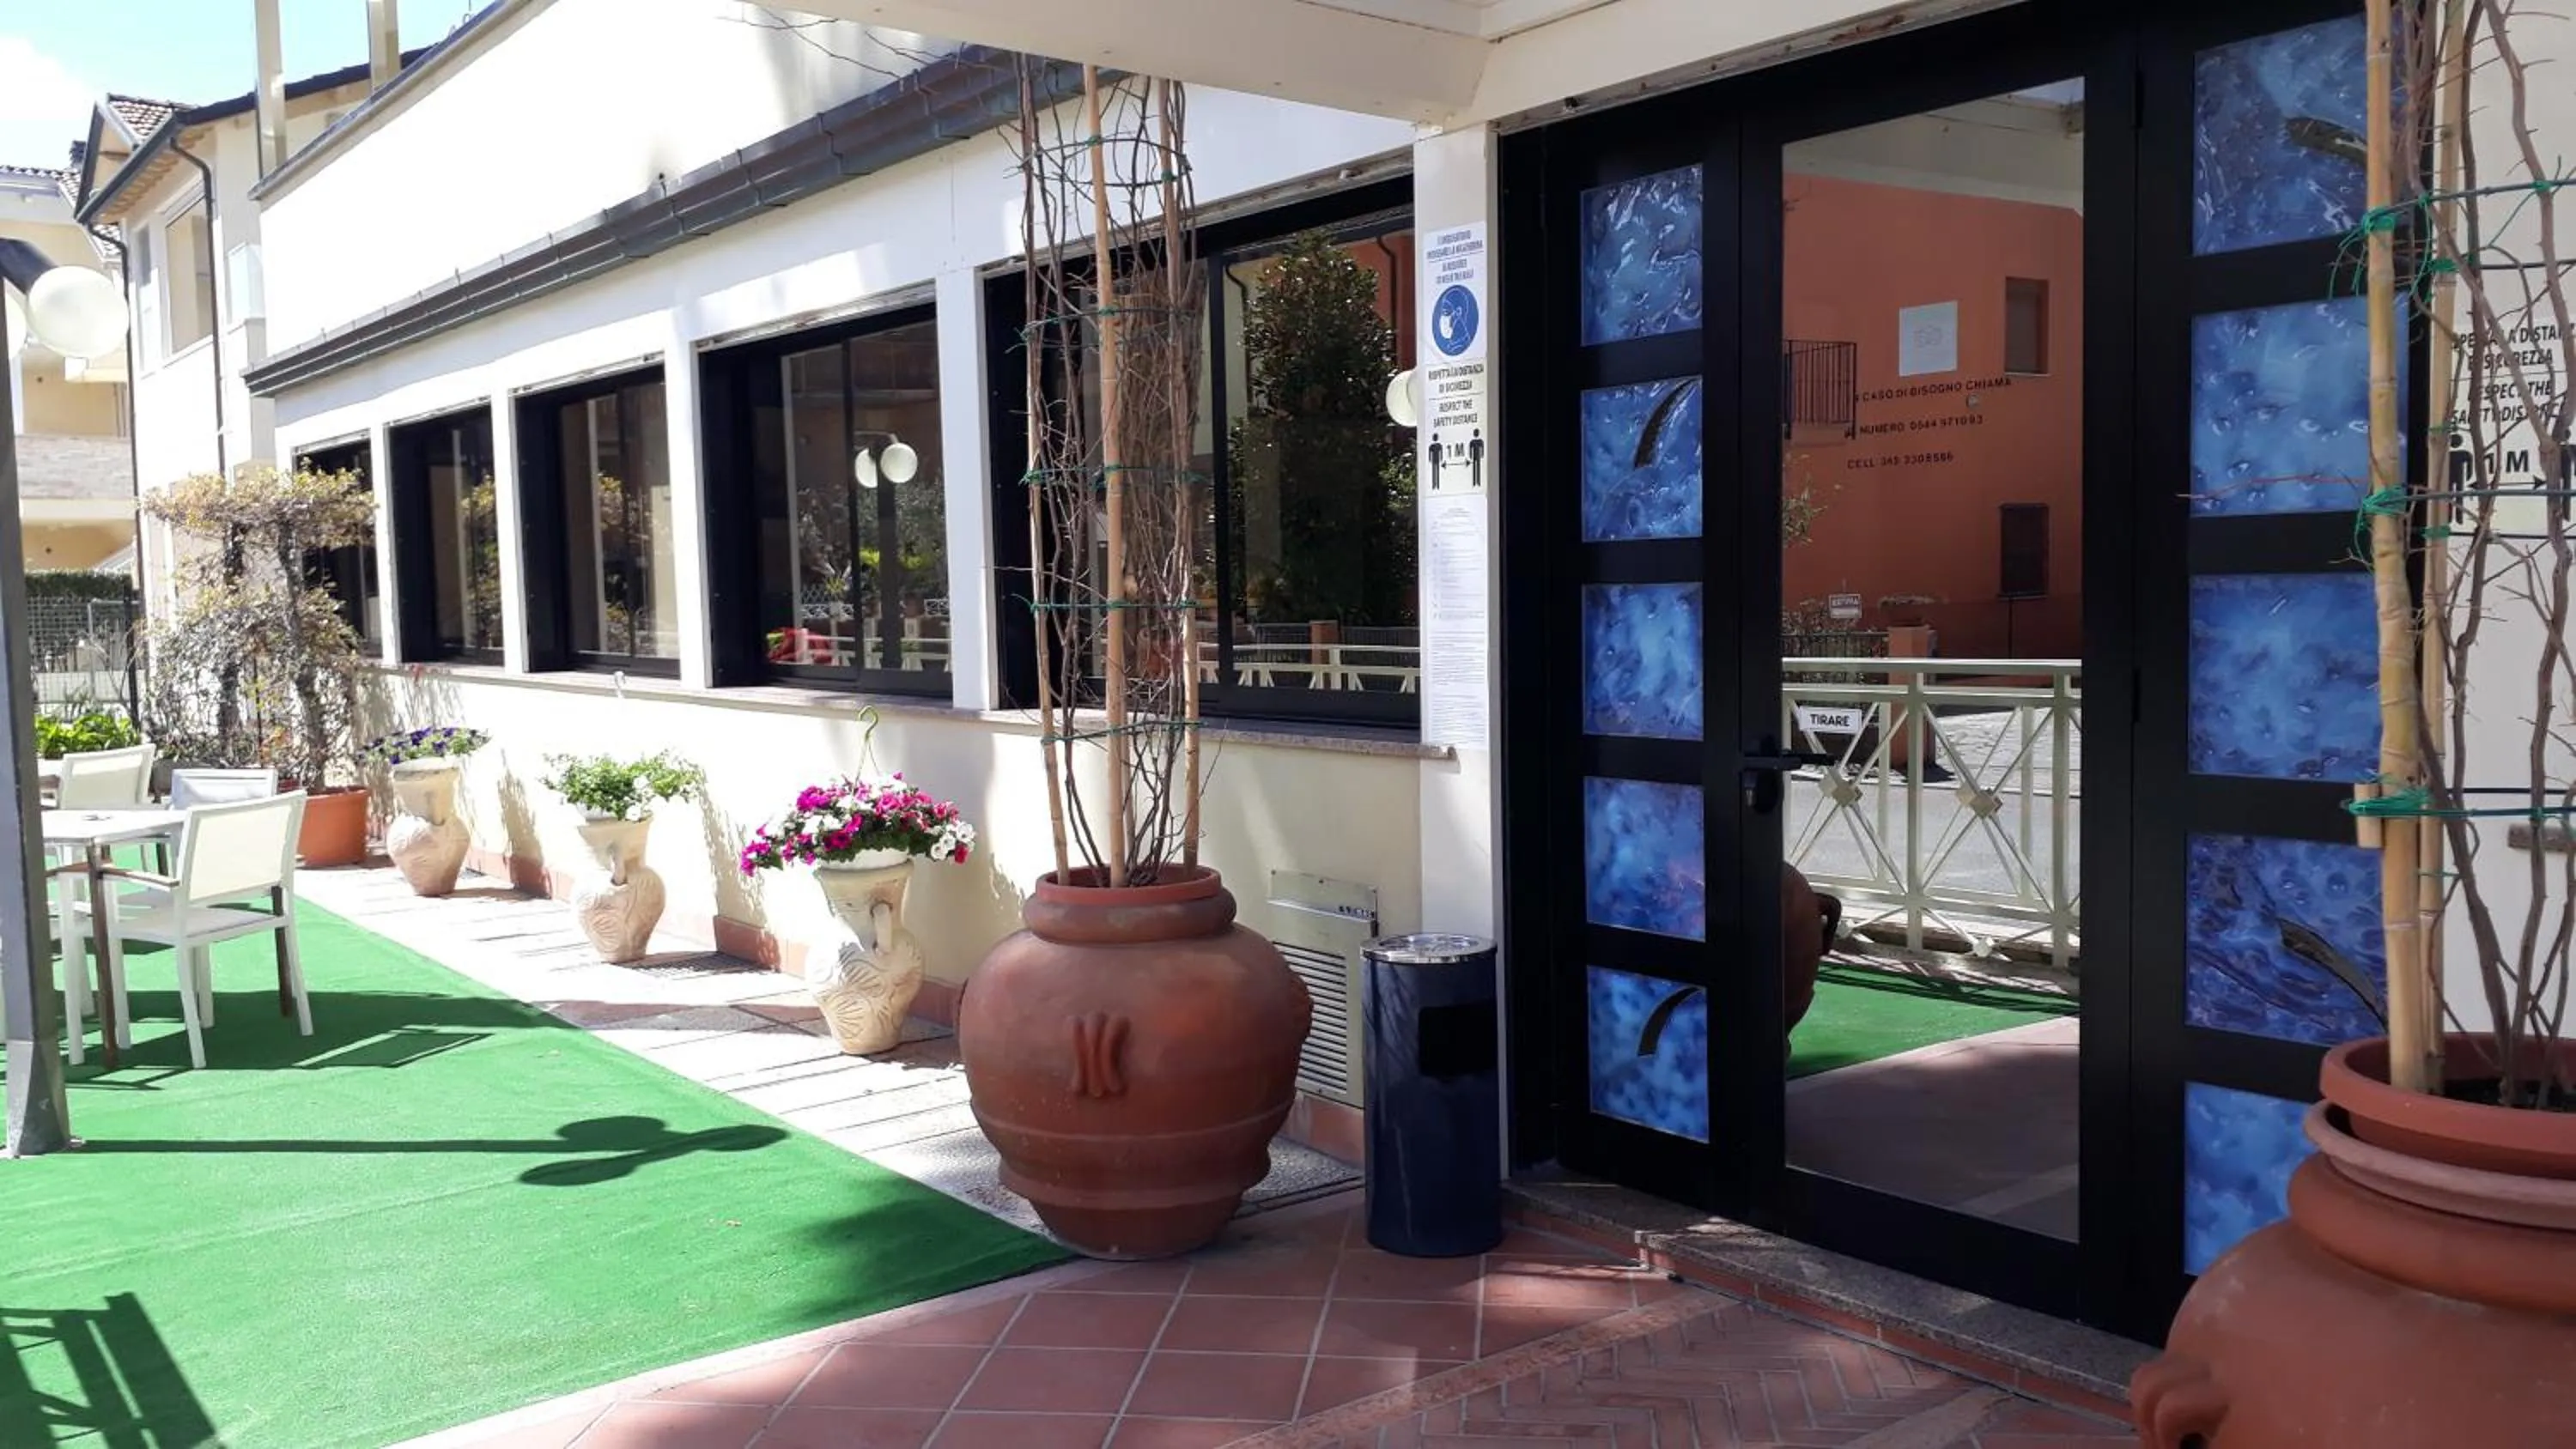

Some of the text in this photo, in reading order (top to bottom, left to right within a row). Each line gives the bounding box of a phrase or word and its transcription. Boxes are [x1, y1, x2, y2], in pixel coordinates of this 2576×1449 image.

[1862, 389, 1893, 403] CASO
[1896, 388, 1907, 398] DI
[1910, 381, 1963, 397] BISOGNO
[1965, 376, 2012, 391] CHIAMA
[1860, 421, 1905, 434] NUMERO
[1455, 442, 1465, 458] M
[2506, 449, 2529, 473] M
[1810, 712, 1850, 727] TIRARE
